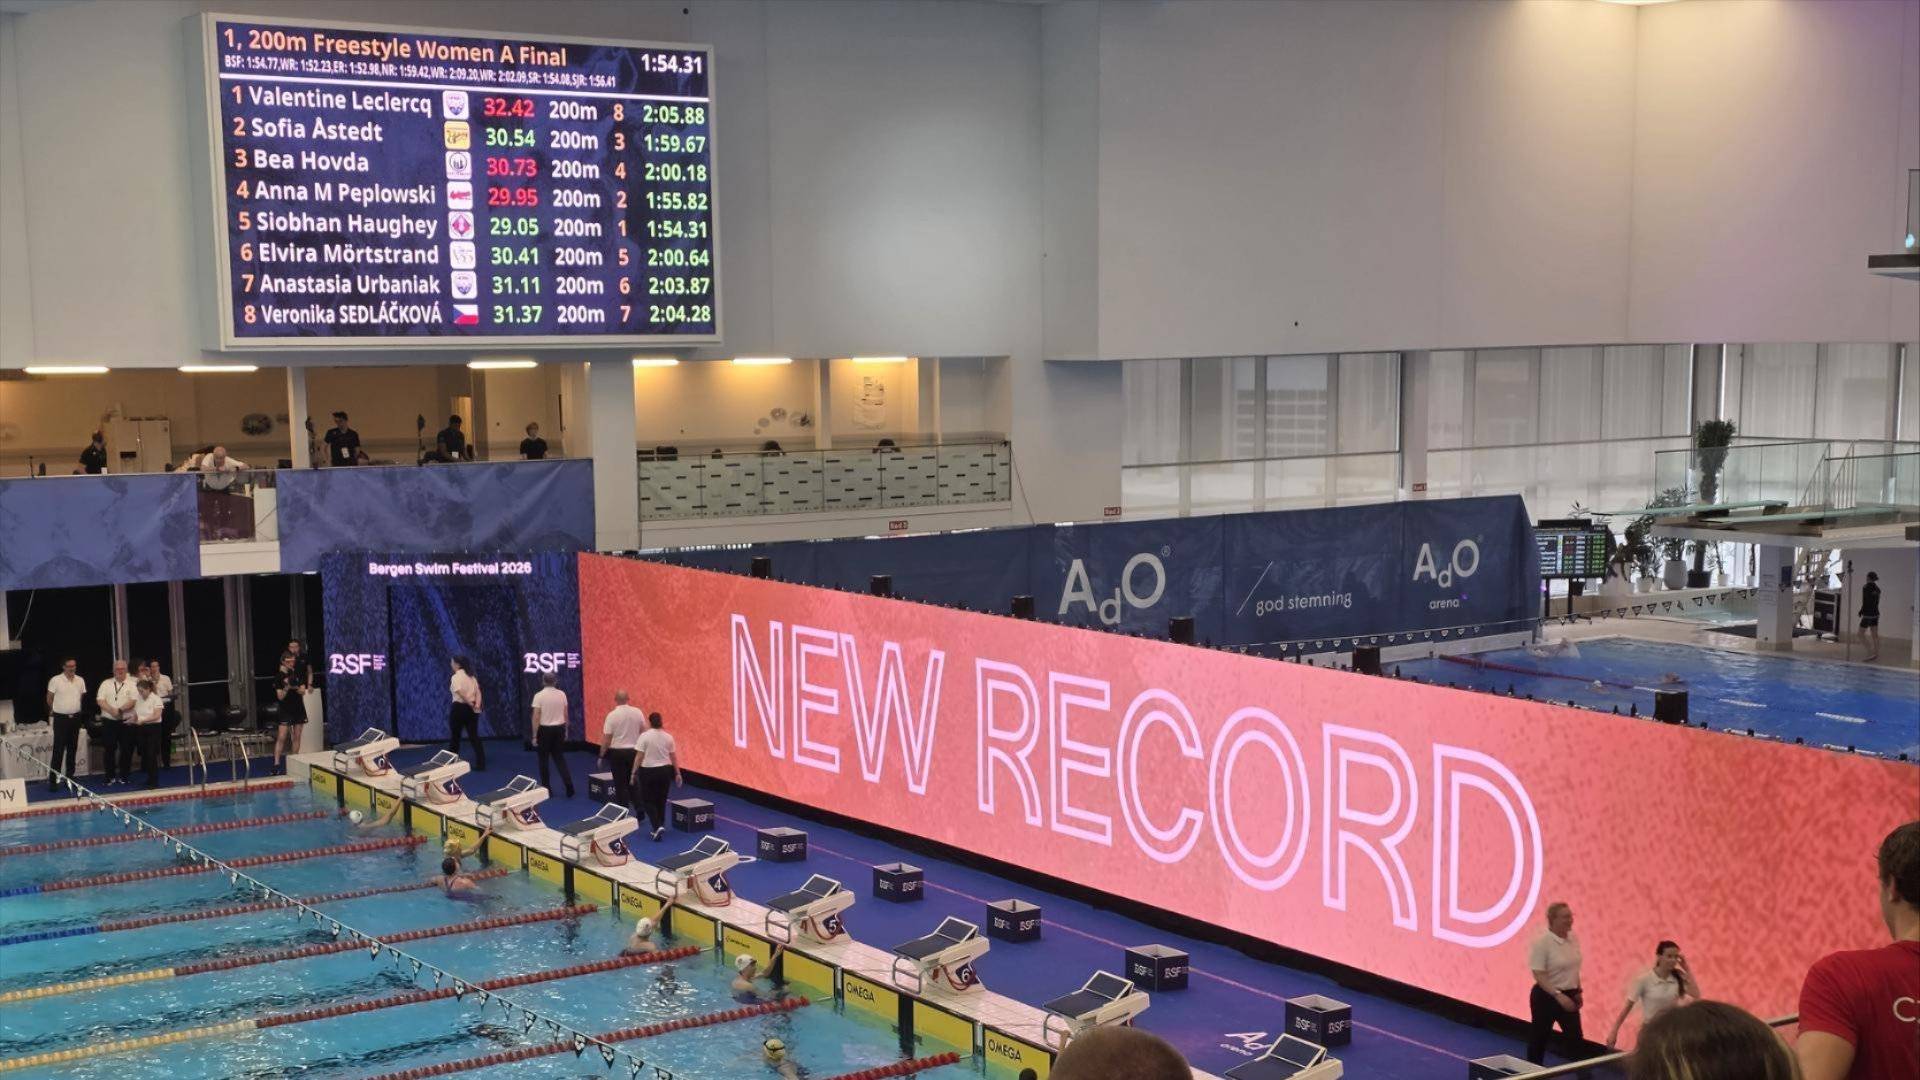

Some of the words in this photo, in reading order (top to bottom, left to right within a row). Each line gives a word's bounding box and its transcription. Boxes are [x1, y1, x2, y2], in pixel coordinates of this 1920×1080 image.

[224, 28, 242, 51] 1,
[249, 29, 307, 52] 200m
[314, 33, 411, 62] Freestyle
[416, 40, 494, 63] Women
[500, 47, 515, 64] A
[520, 46, 567, 67] Final
[224, 55, 245, 69] BSF:
[641, 53, 703, 74] 1:54.31
[232, 85, 242, 104] 1
[249, 86, 346, 109] Valentine
[352, 91, 432, 119] Leclercq
[483, 97, 535, 117] 32.42
[549, 101, 597, 120] 200m
[613, 103, 624, 122] 8
[643, 105, 705, 124] 2:05.88
[233, 117, 246, 137] 2
[252, 117, 306, 139] Sofia
[312, 117, 383, 142] Åstedt
[486, 128, 536, 147] 30.54
[550, 131, 598, 150] 200m
[614, 133, 626, 151] 3
[644, 134, 706, 153] 1:59.67
[235, 148, 248, 169] 3
[254, 149, 294, 170] Bea
[301, 150, 369, 172] Hovda
[486, 157, 537, 177] 30.73
[551, 160, 600, 179] 200m
[614, 162, 627, 180] 4
[645, 163, 707, 182] 2:00.18
[236, 180, 249, 199] 4
[254, 181, 308, 201] Anna
[314, 182, 332, 202] M
[338, 183, 436, 208] Peplowski
[488, 188, 539, 207] 29.95
[552, 189, 601, 208] 200m
[616, 190, 628, 208] 2
[646, 192, 708, 210] 1:55.82
[238, 211, 251, 230] 5
[257, 211, 342, 233] Siobhan
[348, 214, 438, 239] Haughey
[490, 217, 539, 236] 29.05
[554, 219, 602, 238] 200m
[618, 220, 627, 237] 1
[647, 221, 707, 239] 1:54.31
[240, 243, 253, 261] 6
[259, 243, 317, 263] Elvira
[324, 243, 439, 264] Mörtstrand
[491, 247, 539, 265] 30.41
[555, 248, 603, 266] 200m
[618, 249, 629, 266] 5
[647, 249, 709, 267] 2:00.64
[241, 274, 254, 292] 7
[260, 274, 351, 293] Anastasia
[357, 274, 441, 294] Urbaniak
[492, 276, 541, 294] 31.11
[556, 277, 604, 295] 200m
[619, 277, 630, 294] 6
[649, 277, 710, 295] 2:03.87
[244, 304, 256, 324] 8
[261, 304, 335, 324] Veronika
[339, 301, 442, 324] SEDLÁČKOVÁ
[493, 305, 543, 323] 31.37
[557, 305, 605, 323] 200m
[620, 305, 631, 322] 7
[649, 305, 711, 323] 2:04.28
[369, 562, 413, 577] Bergen
[415, 562, 450, 575] Swim
[452, 562, 499, 575] Festival
[501, 562, 532, 575] 2026
[1412, 539, 1480, 588] AdO
[1058, 553, 1166, 625] AdO
[1255, 596, 1284, 616] god
[1287, 591, 1353, 609] stemning
[1429, 598, 1460, 610] arena
[329, 653, 372, 675] BSF
[523, 652, 566, 673] BSF
[730, 613, 946, 796] NEW
[975, 657, 1544, 949] RECORD
[620, 893, 643, 910] OMEGA
[829, 919, 837, 934] 5
[961, 968, 970, 983] 6
[846, 982, 875, 1004] OMEGA
[988, 1039, 1023, 1063] OMEGA
